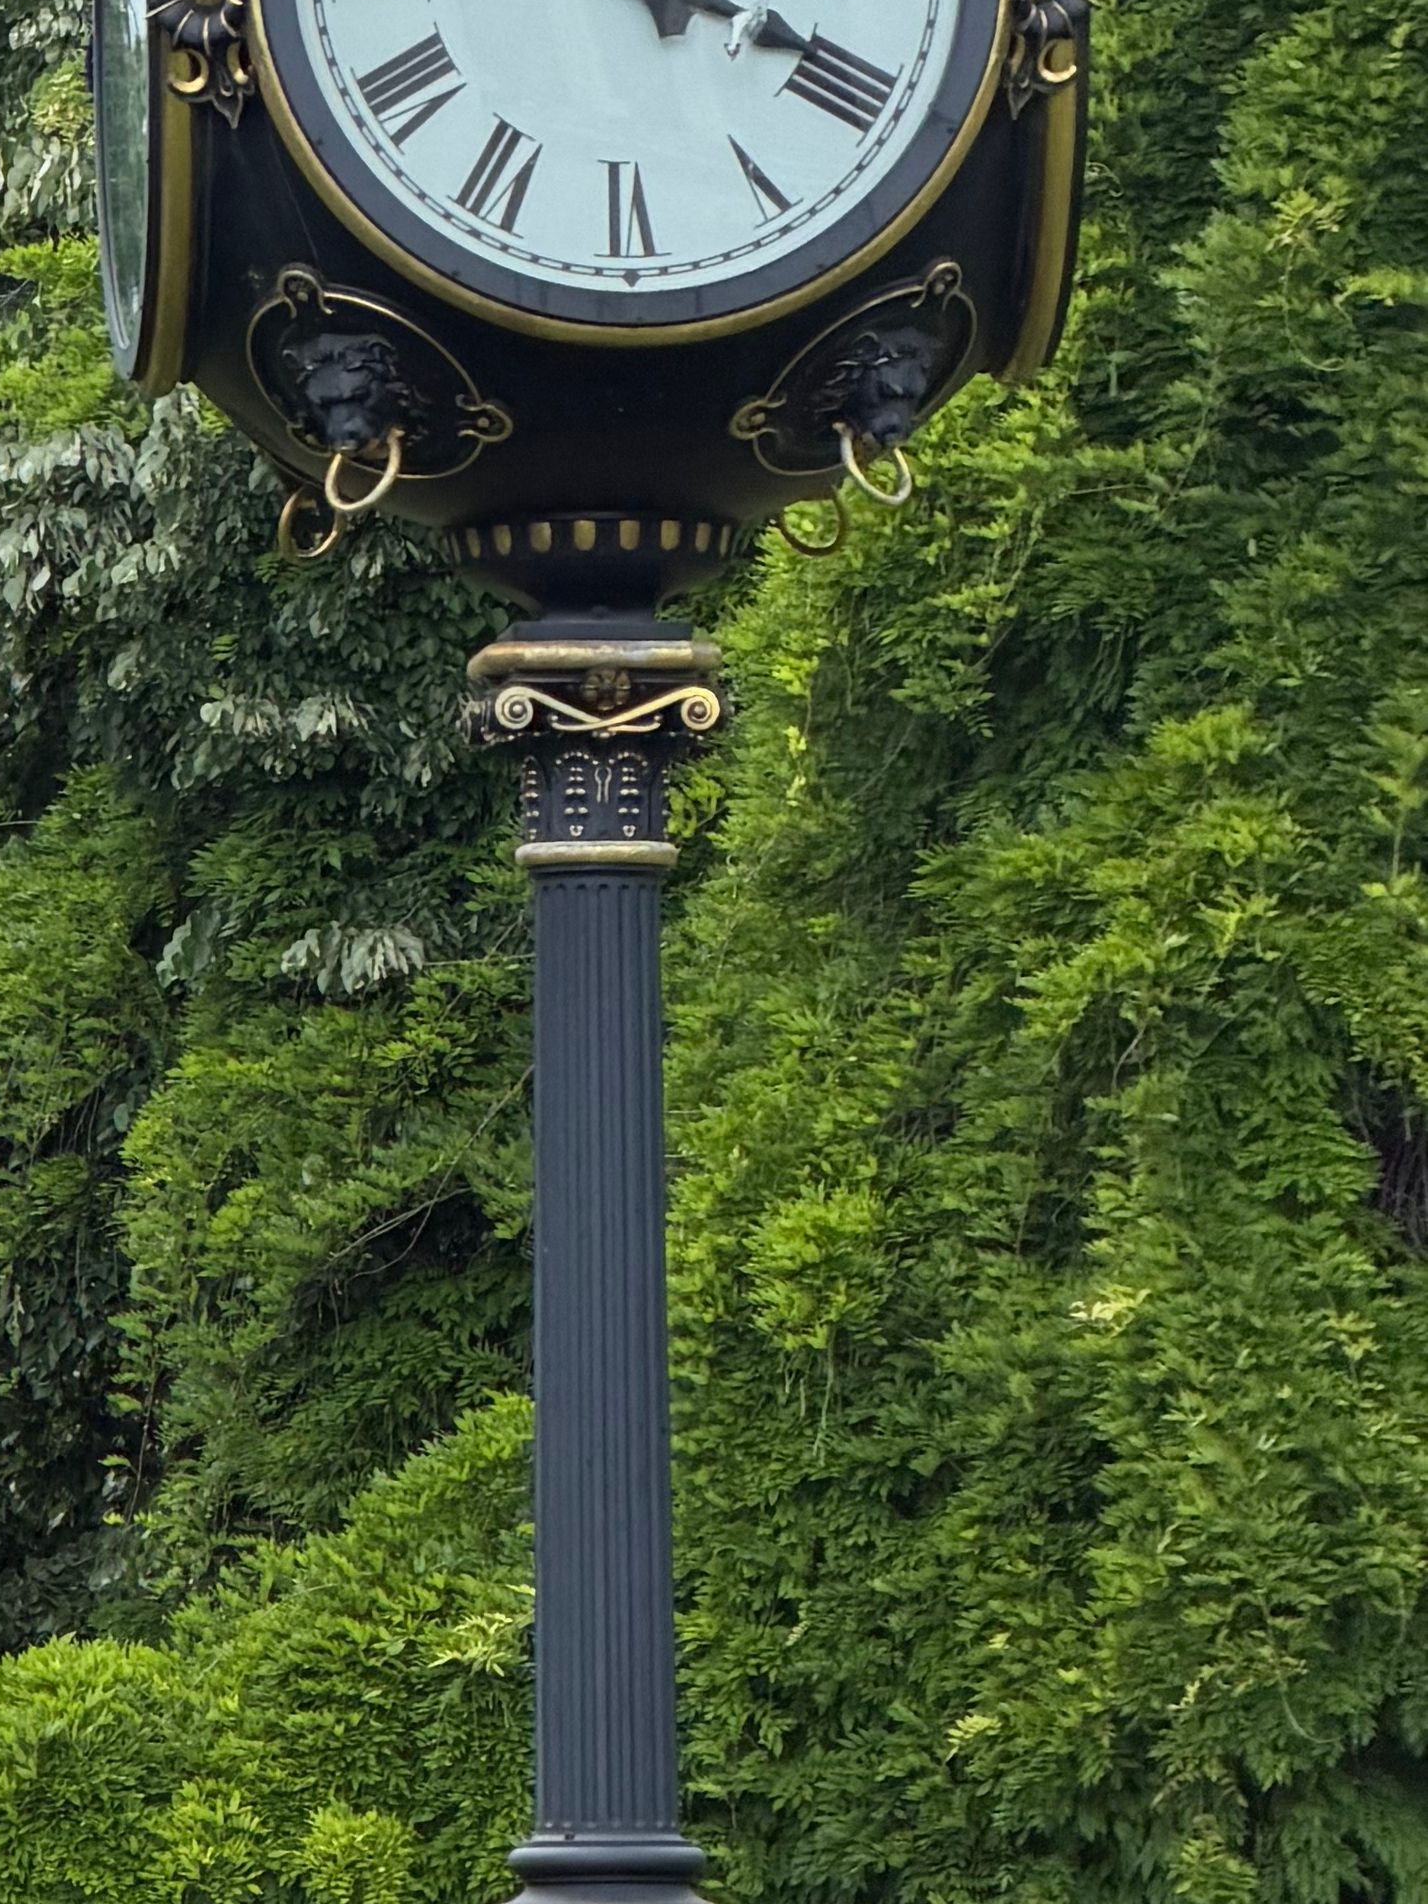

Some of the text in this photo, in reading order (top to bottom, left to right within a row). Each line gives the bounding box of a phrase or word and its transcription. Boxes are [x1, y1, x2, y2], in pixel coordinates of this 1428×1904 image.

[349, 22, 467, 155] VIII
[774, 22, 904, 147] IIII
[447, 112, 543, 238] VII
[594, 159, 672, 258] VI
[727, 133, 802, 228] V
